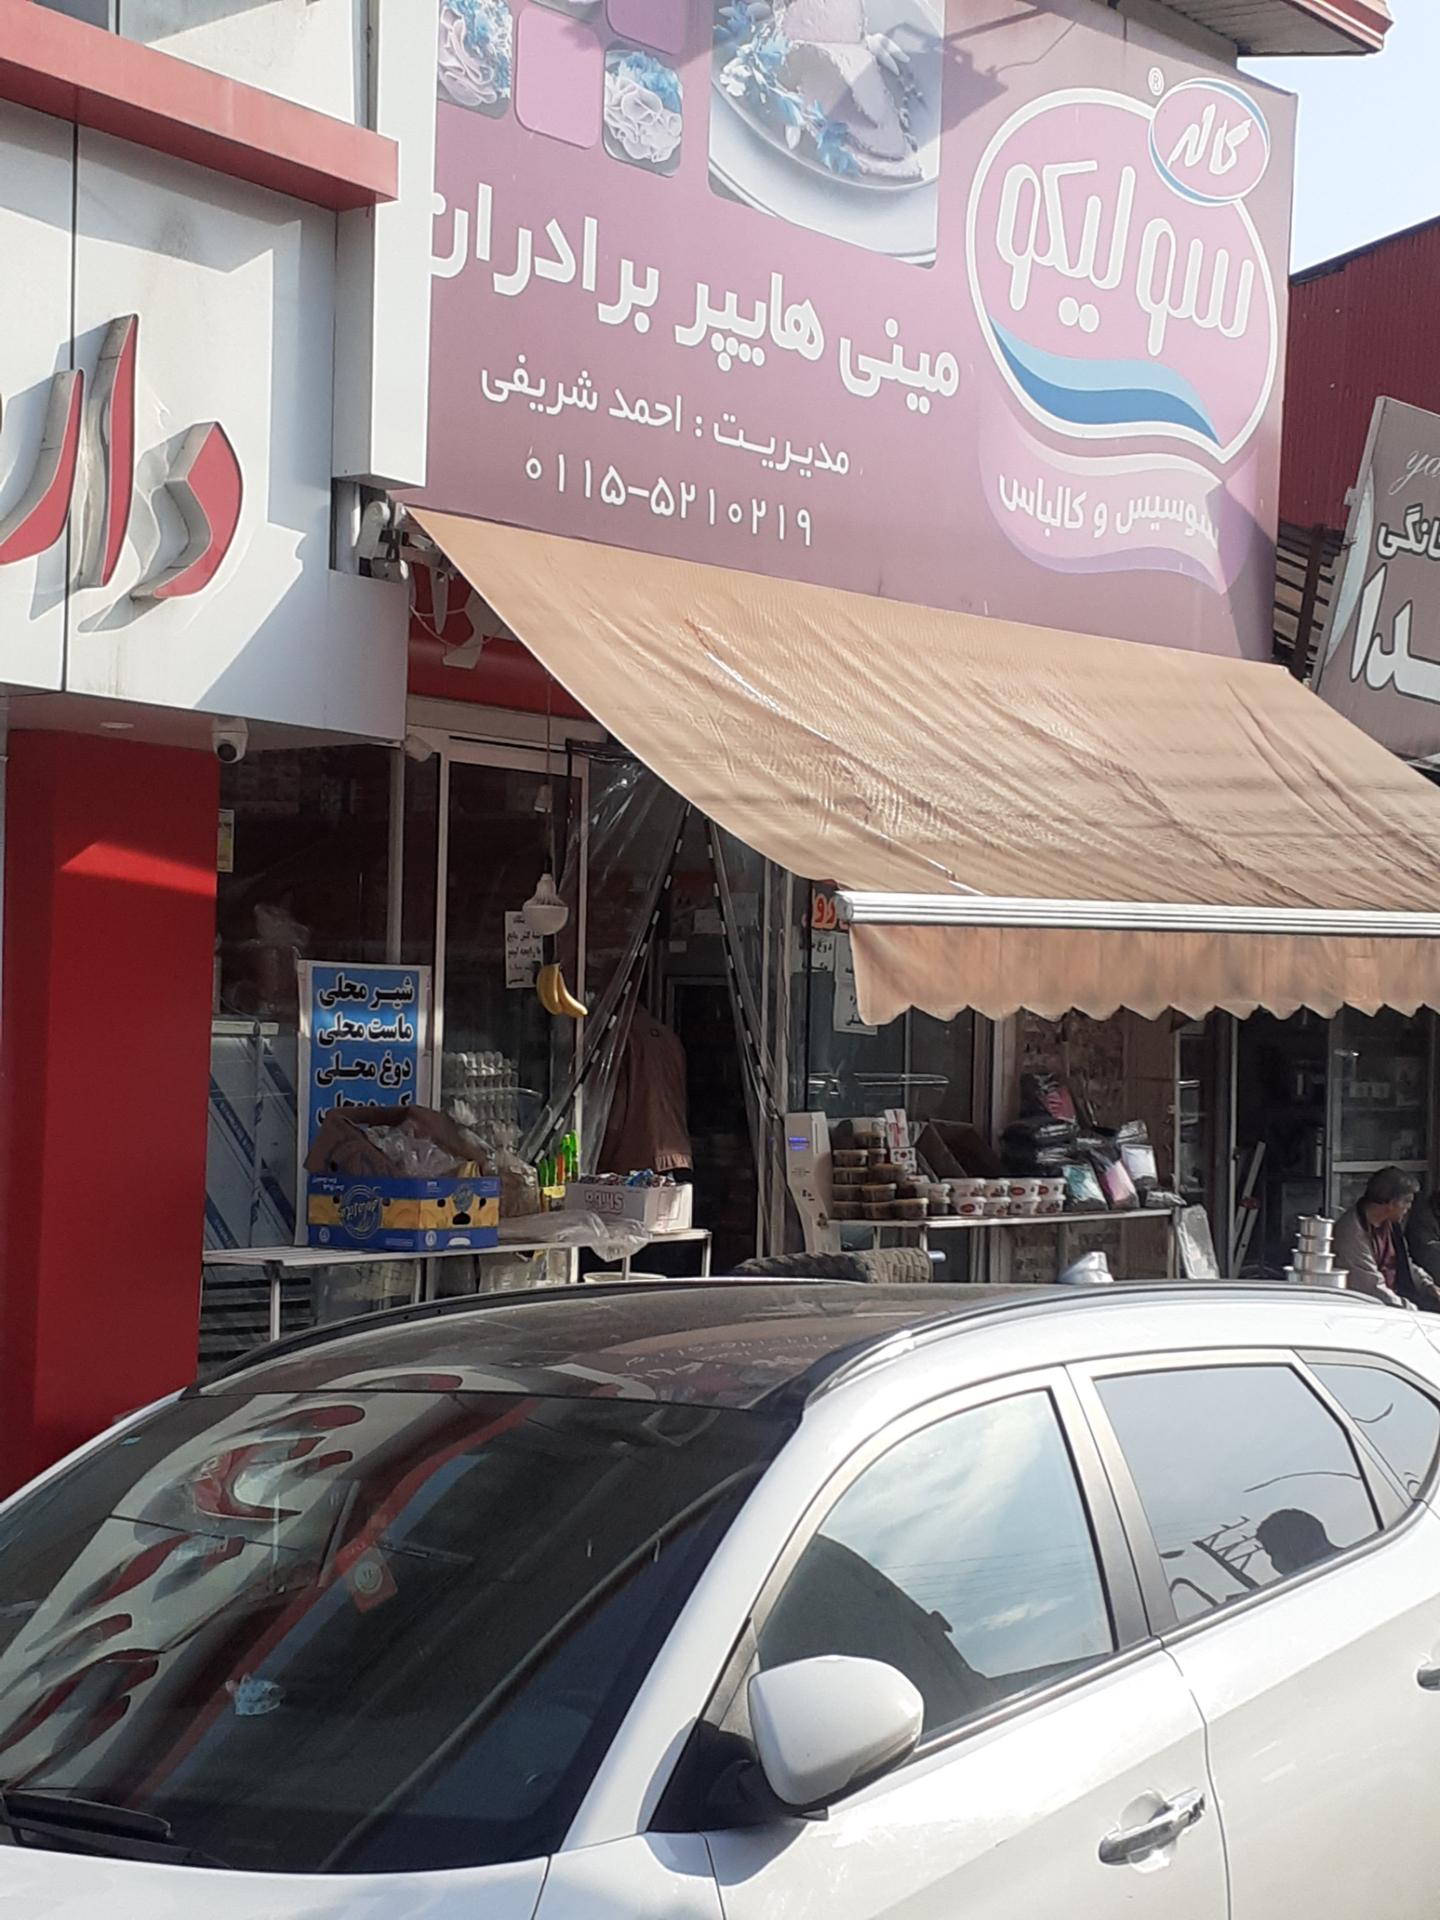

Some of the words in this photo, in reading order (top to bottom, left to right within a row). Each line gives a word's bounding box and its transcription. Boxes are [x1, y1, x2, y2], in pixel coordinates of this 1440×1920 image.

[1166, 103, 1252, 175] کاله
[996, 159, 1255, 357] سولیکو
[673, 271, 825, 372] هایپر
[480, 353, 599, 415] شریفی
[839, 317, 960, 415] مینی
[607, 388, 683, 433] احمد
[713, 412, 850, 478] مدیریت
[998, 473, 1088, 537] کالباس
[1093, 502, 1109, 538] و
[318, 972, 368, 1008] محلی
[368, 976, 415, 1010] شیر
[317, 1011, 366, 1047] محلی
[367, 1012, 413, 1042] ماست
[315, 1050, 377, 1087] محلی
[377, 1050, 412, 1088] دوغ
